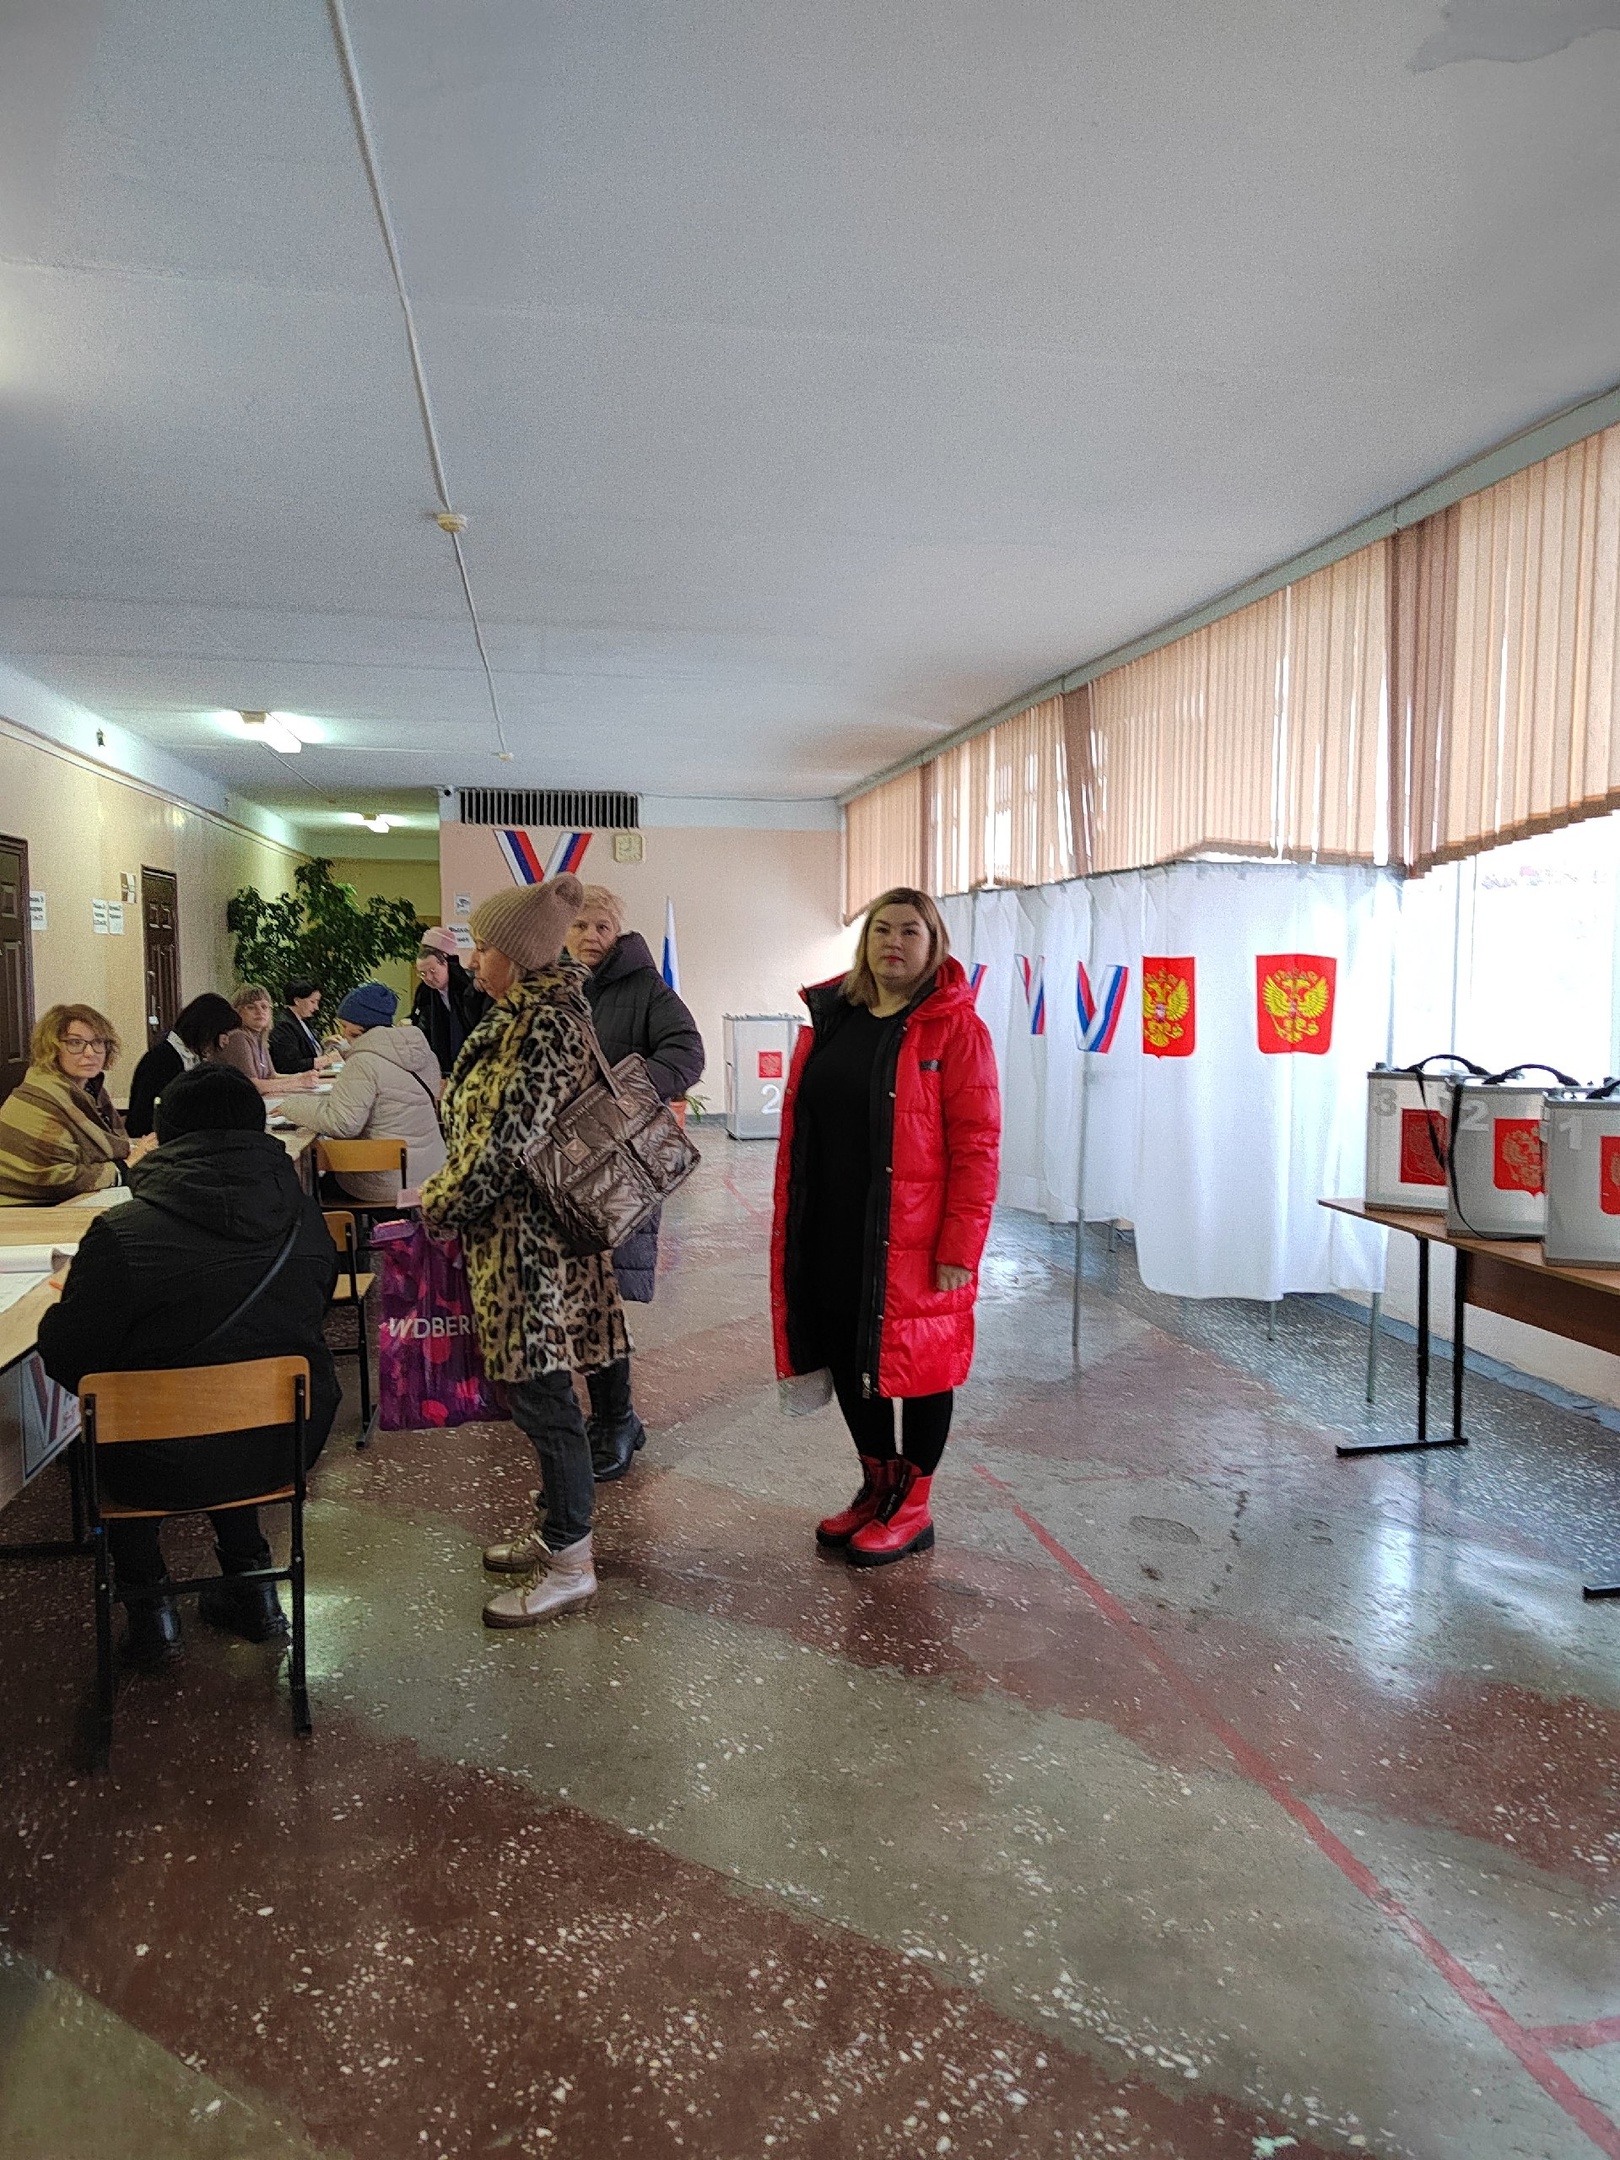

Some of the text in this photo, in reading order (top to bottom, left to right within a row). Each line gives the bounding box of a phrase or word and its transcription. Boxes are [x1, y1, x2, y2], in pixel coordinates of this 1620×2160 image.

[761, 1084, 781, 1114] 2
[1373, 1087, 1398, 1117] 3
[1459, 1100, 1489, 1131] 2
[1559, 1115, 1582, 1151] 1
